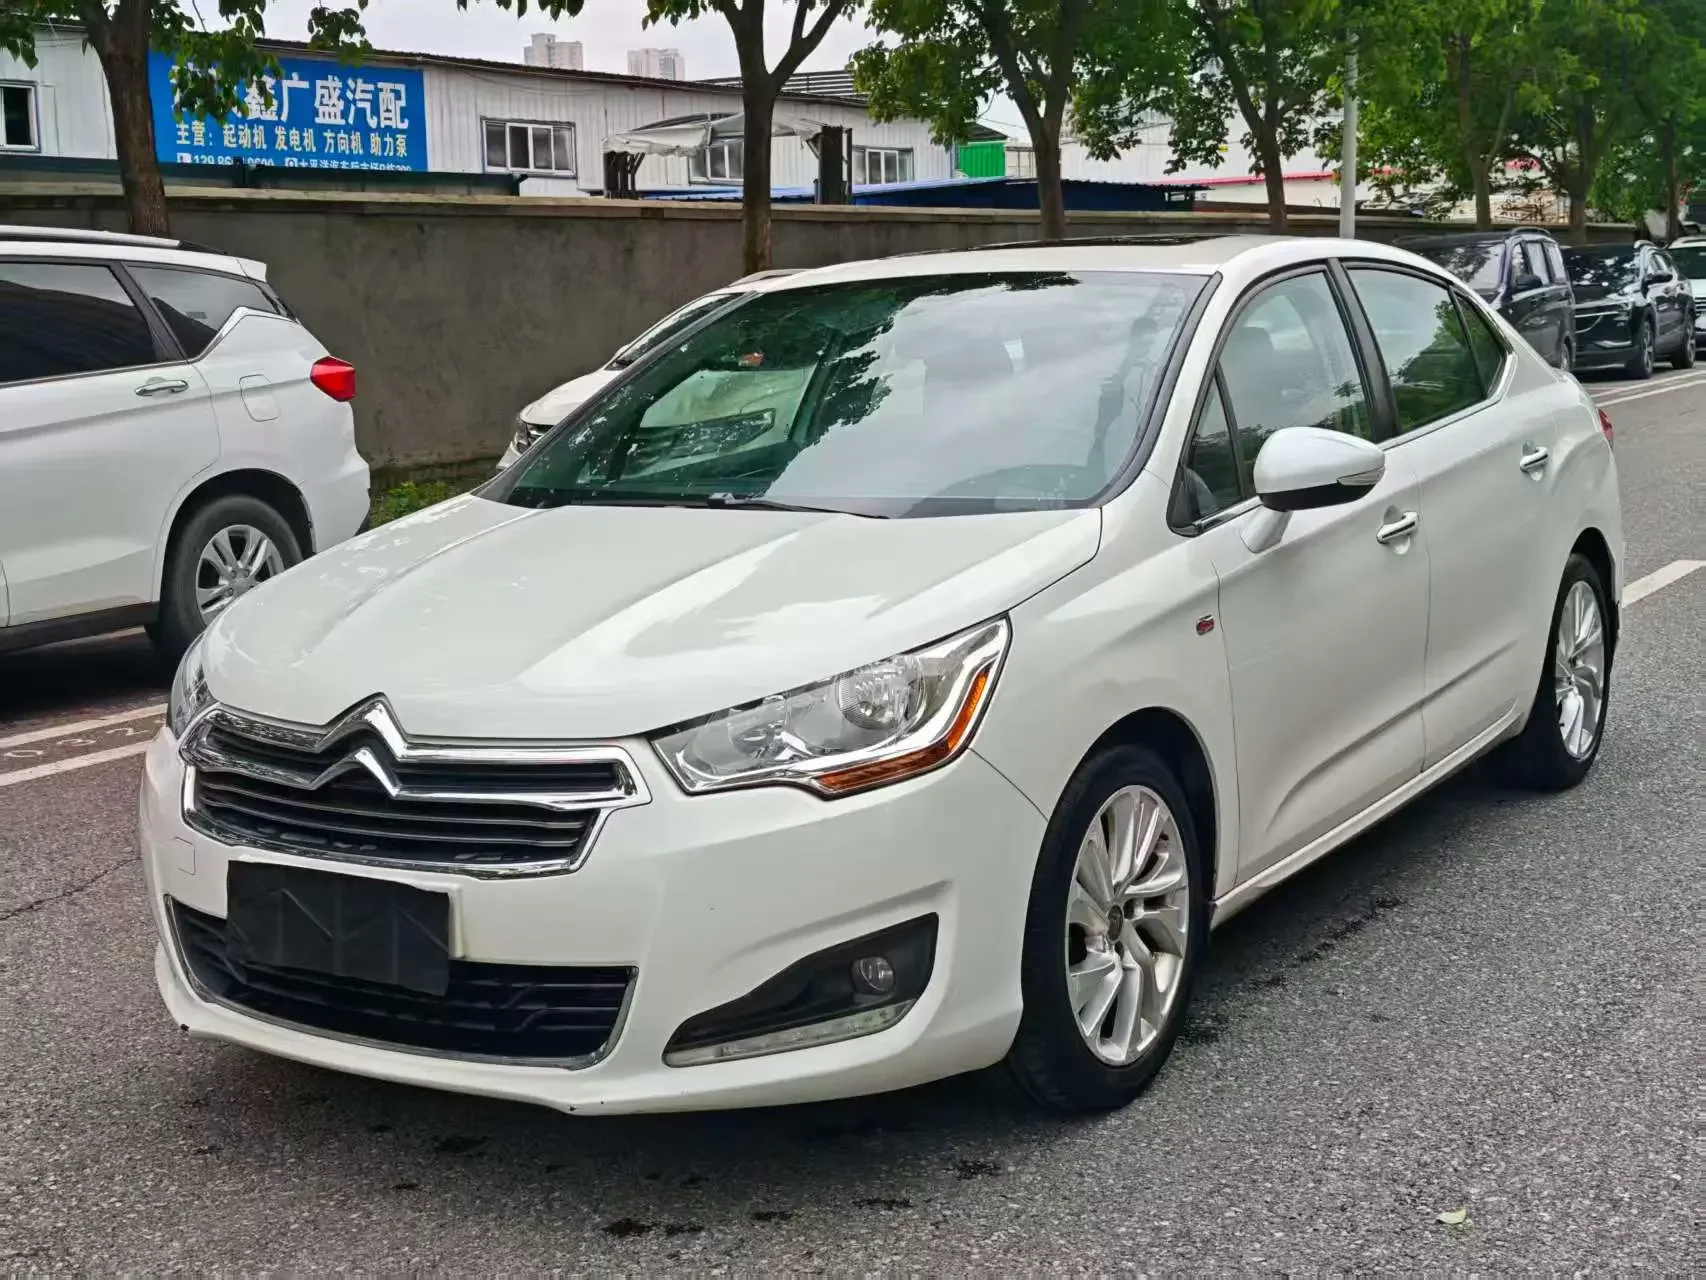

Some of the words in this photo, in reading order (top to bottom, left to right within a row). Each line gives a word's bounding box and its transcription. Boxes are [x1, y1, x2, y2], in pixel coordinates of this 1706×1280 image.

[171, 62, 409, 129] 鑫广盛汽配
[222, 122, 267, 149] 起动机
[275, 125, 316, 152] 发电机
[322, 129, 364, 155] 方向机
[369, 131, 407, 157] 助力泵
